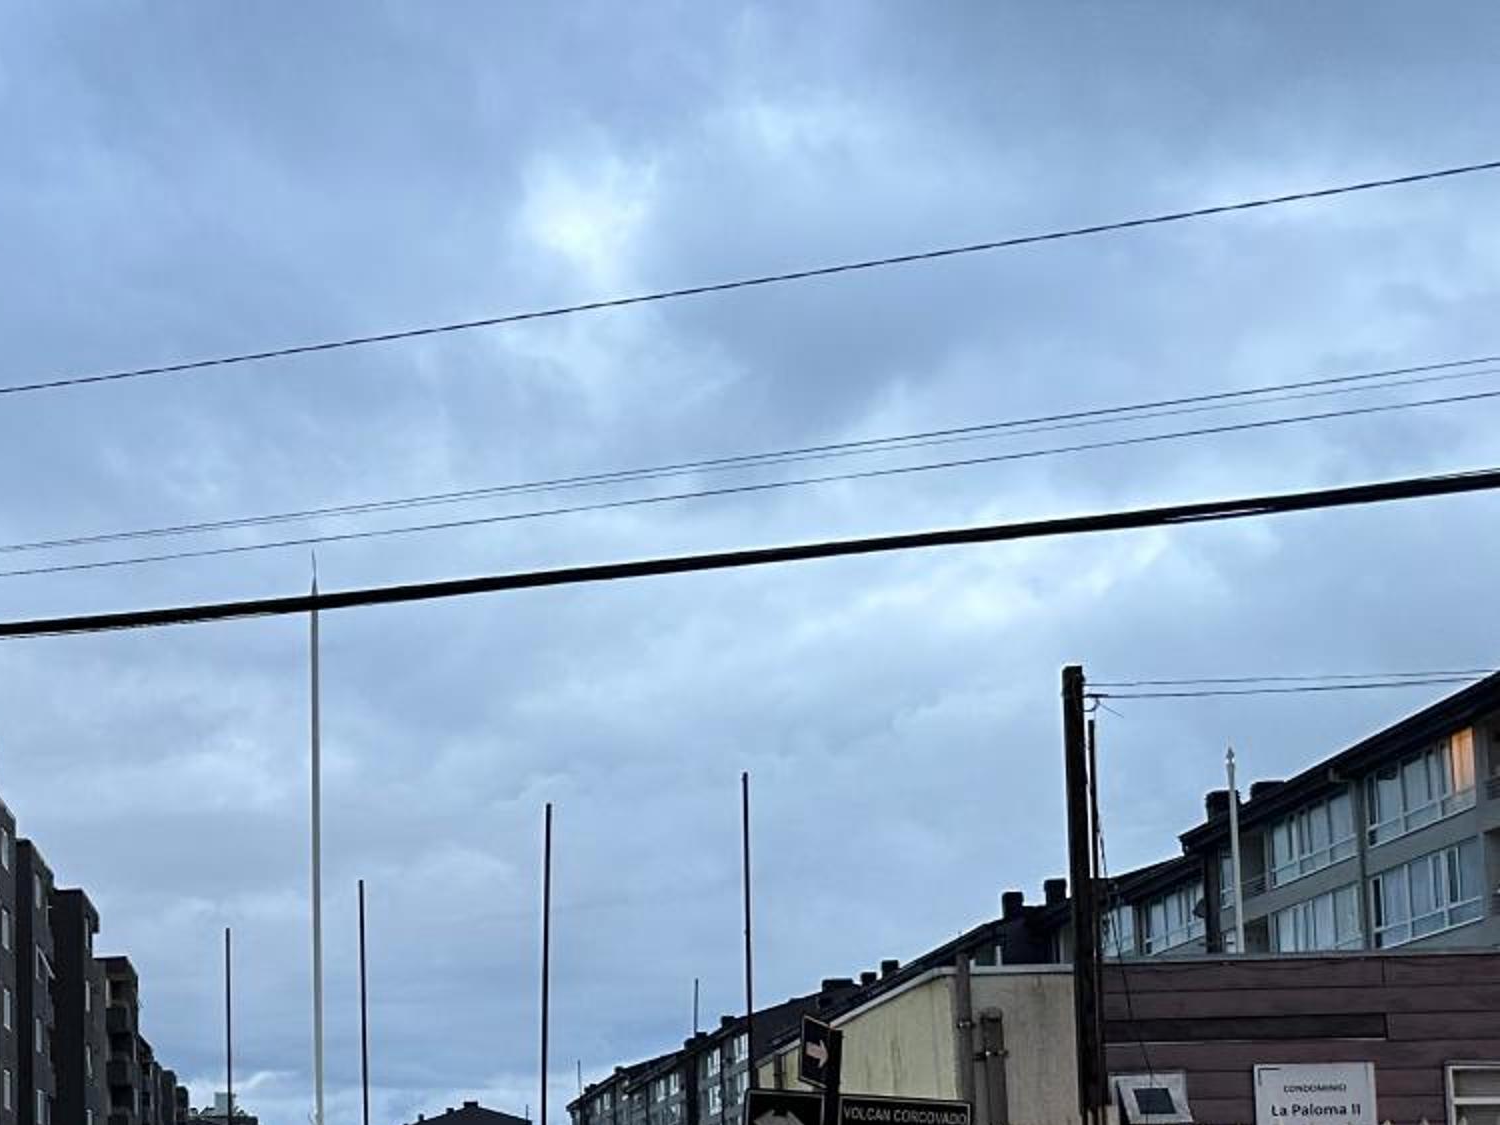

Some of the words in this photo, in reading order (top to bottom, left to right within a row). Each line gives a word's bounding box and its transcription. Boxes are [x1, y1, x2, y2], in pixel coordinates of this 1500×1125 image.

[843, 1106, 891, 1121] VOLCAN
[1271, 1104, 1288, 1117] La
[1291, 1103, 1347, 1117] Paloma
